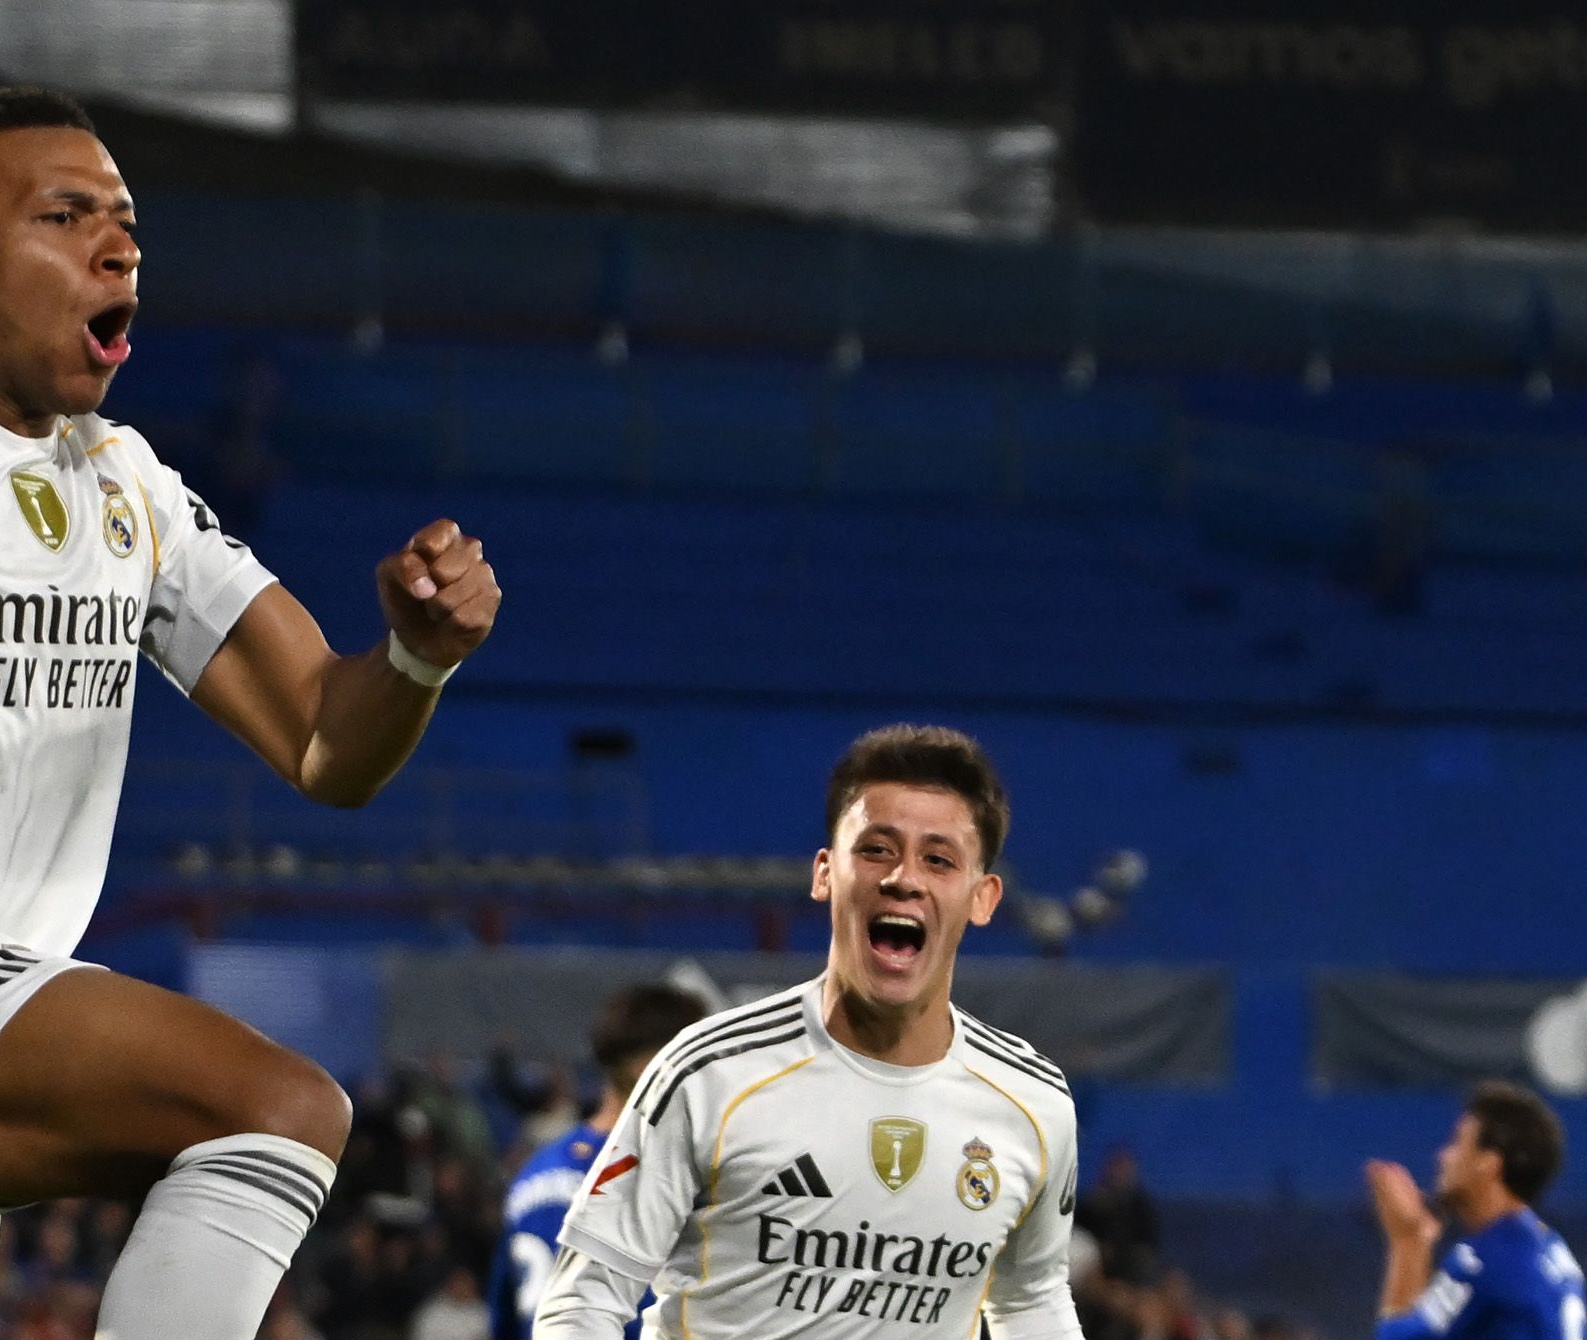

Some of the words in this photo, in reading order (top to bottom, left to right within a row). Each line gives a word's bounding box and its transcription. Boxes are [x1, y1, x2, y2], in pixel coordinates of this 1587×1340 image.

[47, 658, 132, 709] BETTER
[757, 1213, 993, 1278] Emirates
[776, 1271, 837, 1314] FLY
[837, 1278, 952, 1324] BETTER
